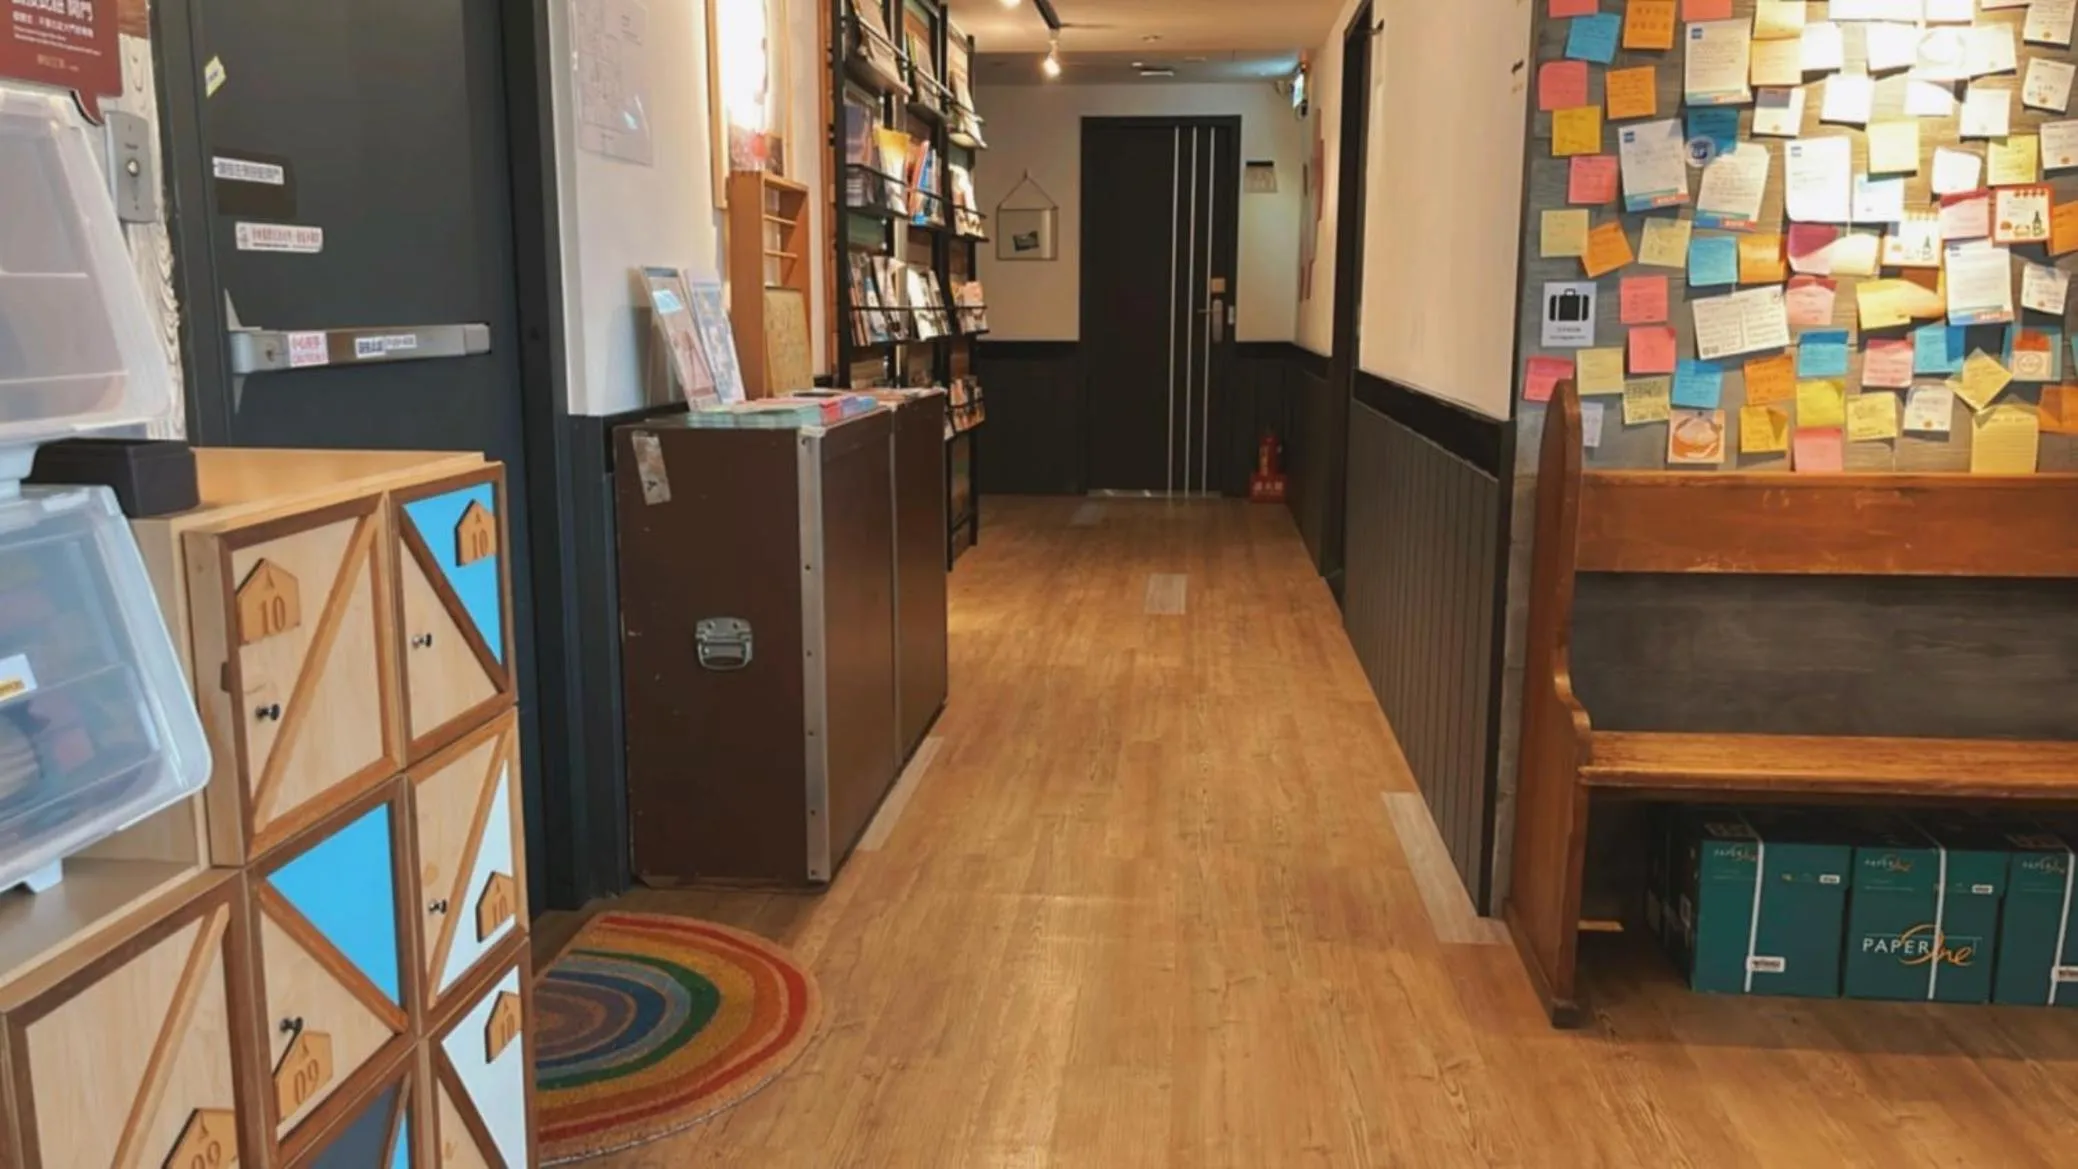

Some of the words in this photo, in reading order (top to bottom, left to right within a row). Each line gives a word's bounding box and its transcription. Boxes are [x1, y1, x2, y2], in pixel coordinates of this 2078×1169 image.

[471, 529, 489, 560] 10
[258, 596, 286, 635] 10
[1862, 937, 1930, 955] PAPER
[293, 1058, 320, 1106] 09
